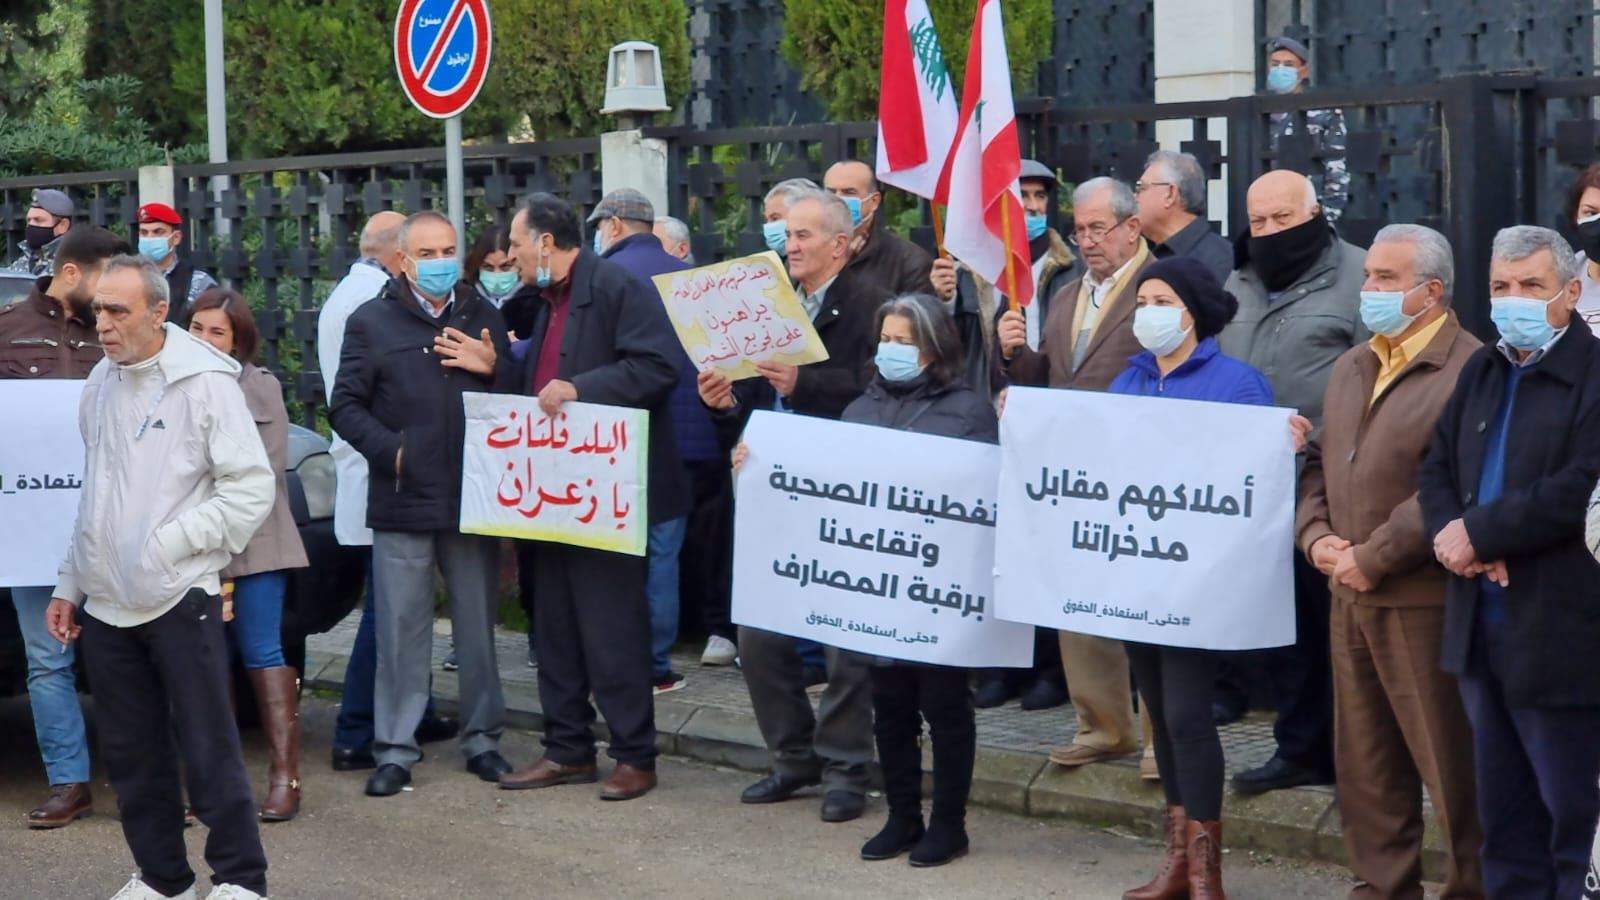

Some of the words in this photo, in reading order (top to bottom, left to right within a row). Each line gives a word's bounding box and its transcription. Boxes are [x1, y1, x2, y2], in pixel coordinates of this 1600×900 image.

[419, 14, 441, 28] ممنوع
[749, 267, 772, 281] بعد
[705, 300, 772, 334] يراهنون
[776, 325, 803, 348] على
[486, 410, 569, 449] فلتان
[569, 419, 628, 465] البلد
[497, 457, 599, 523] زعران
[613, 481, 630, 530] يا
[768, 463, 878, 508] الصحية
[1025, 466, 1109, 507] مقابل
[1118, 474, 1254, 522] أملاكهم
[818, 517, 940, 568] وتقاعدنا
[1071, 520, 1189, 562] مدخراتنا
[772, 553, 899, 600] المصارف
[906, 575, 986, 622] برقبة
